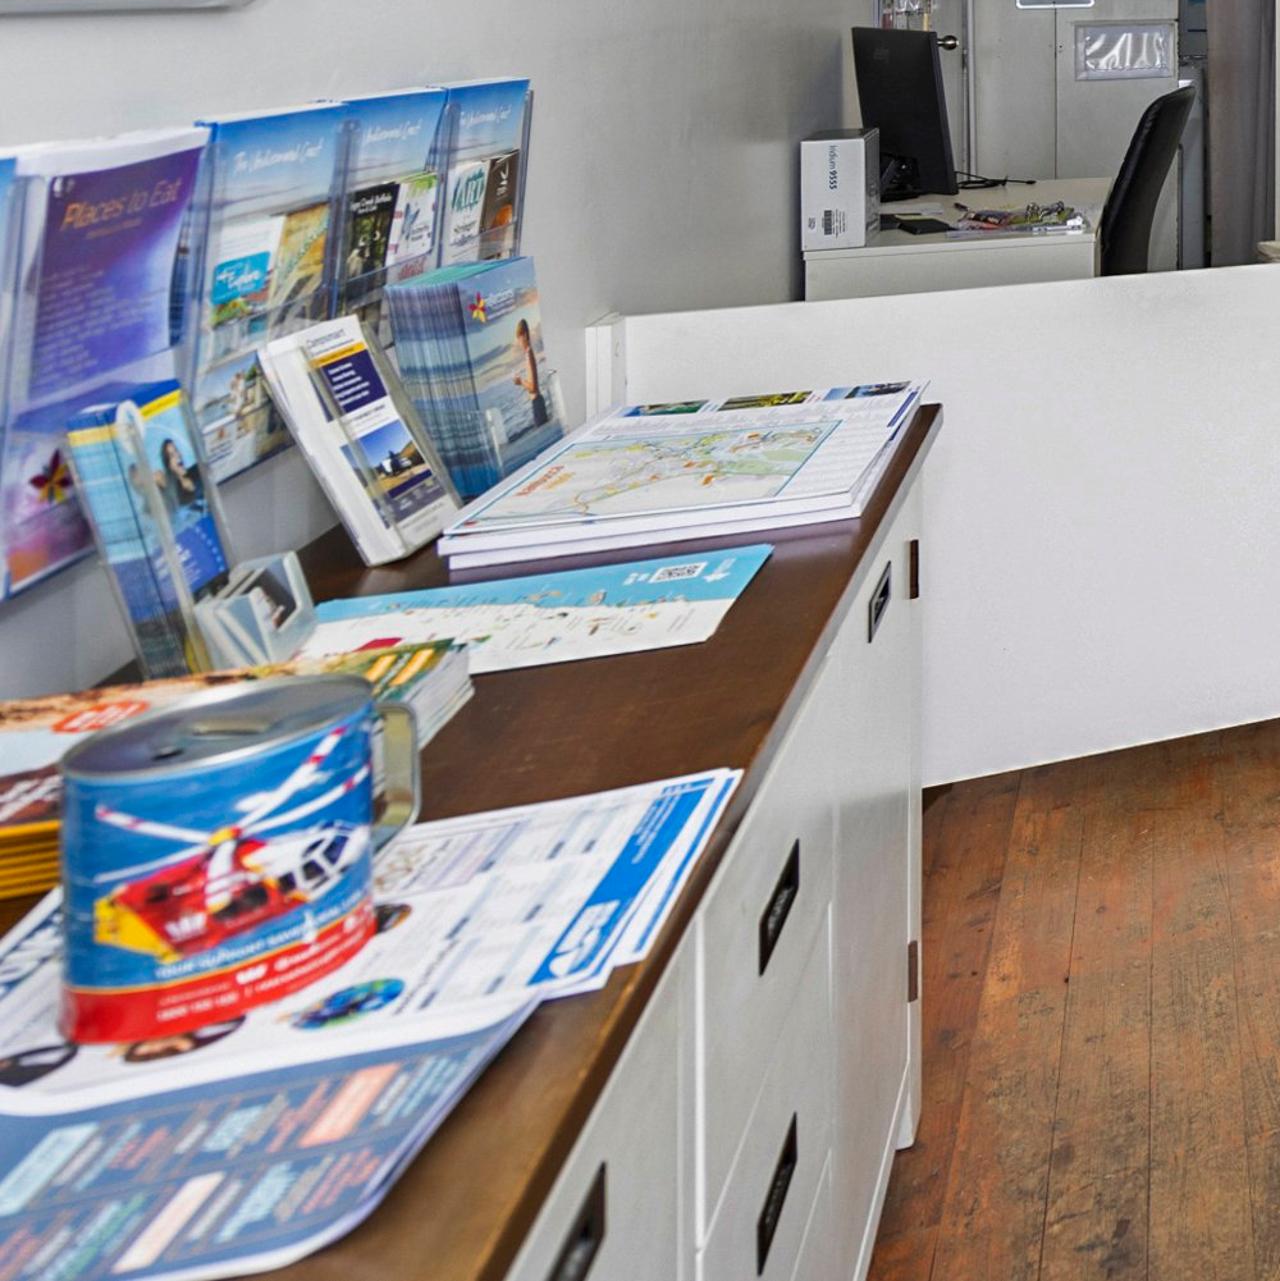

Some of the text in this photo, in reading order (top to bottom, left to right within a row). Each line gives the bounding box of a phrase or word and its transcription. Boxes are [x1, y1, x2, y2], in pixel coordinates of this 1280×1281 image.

[60, 178, 182, 231] Places to Eat
